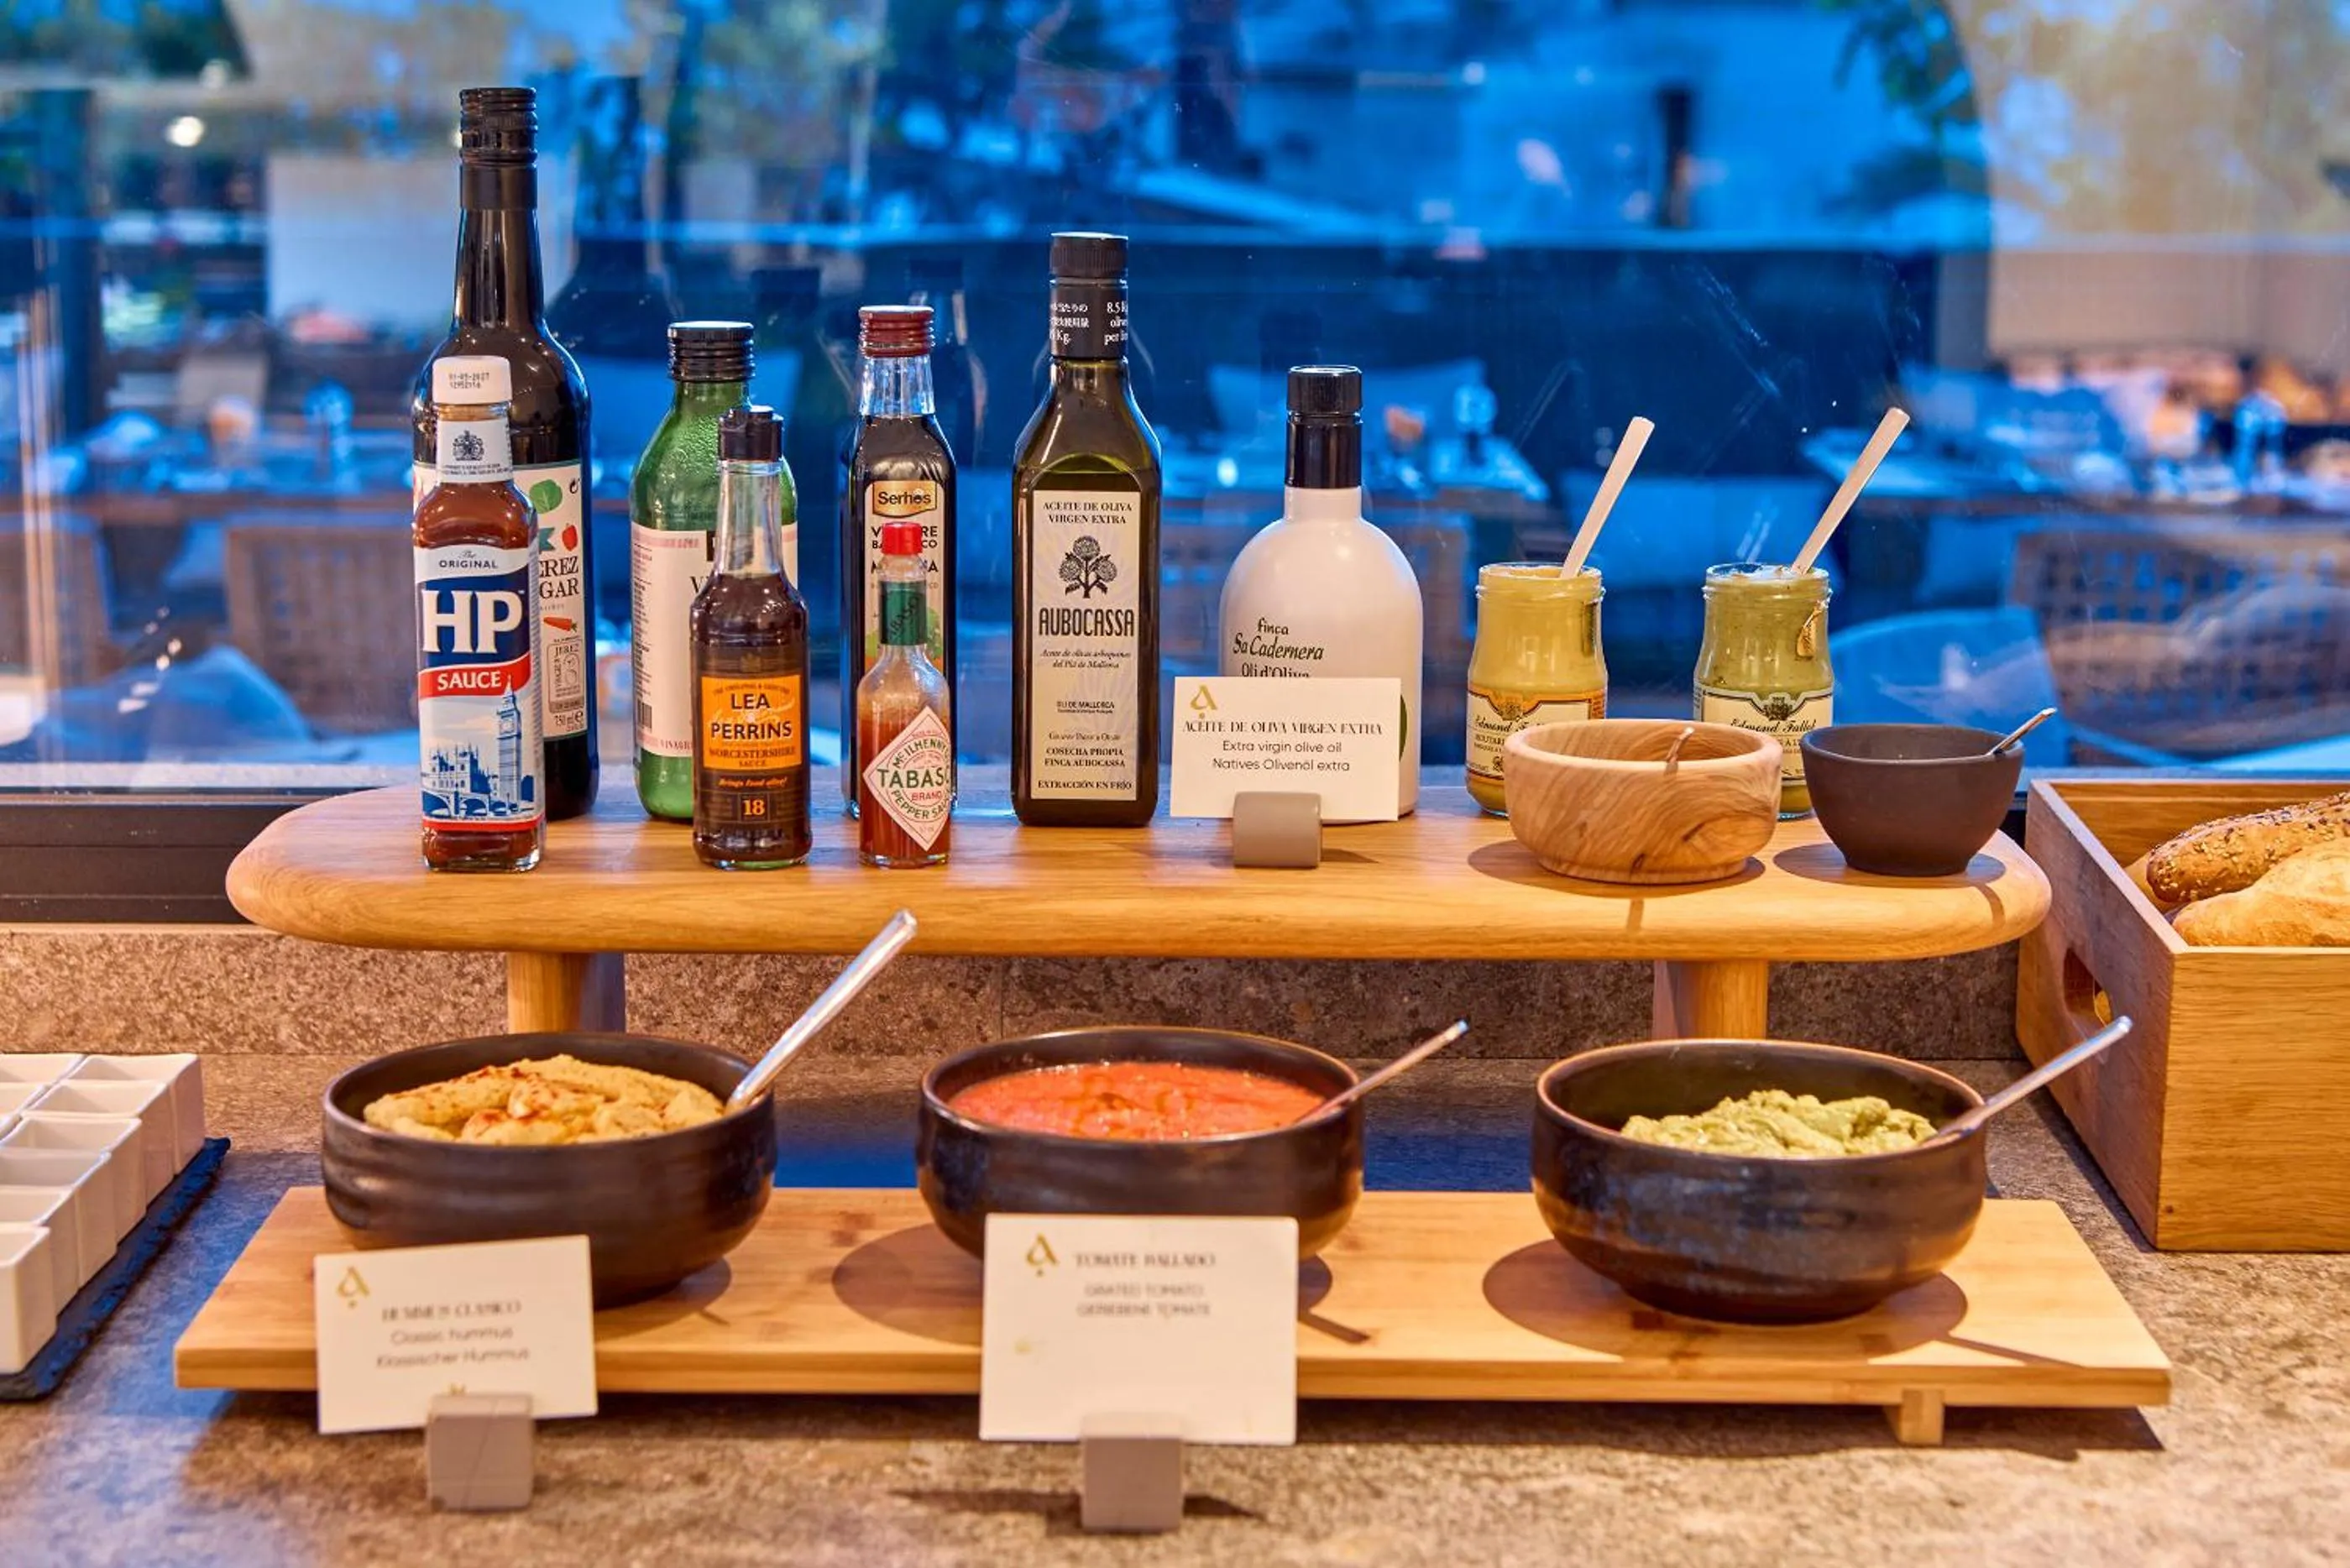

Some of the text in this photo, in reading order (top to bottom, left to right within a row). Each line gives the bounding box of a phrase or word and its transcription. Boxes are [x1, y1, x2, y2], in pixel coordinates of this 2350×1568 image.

[1043, 502, 1133, 511] ACEITE DE OLIVA
[1049, 514, 1127, 524] VIRGEN EXTRA
[438, 559, 498, 569] ORIGINAL
[421, 588, 523, 654] HP
[1039, 607, 1134, 637] AUBOCASSA
[1248, 635, 1324, 661] Cadernera
[437, 671, 502, 691] SAUCE
[730, 693, 772, 710] LEA
[710, 720, 793, 740] PERRINS
[1182, 720, 1384, 735] ACEITE DE OLIVA VIRGEN EXTRA
[1222, 740, 1342, 755] Extra virgin olive oil
[1212, 757, 1260, 771] Natives
[1316, 760, 1351, 771] extra
[1096, 781, 1108, 789] EN
[911, 790, 943, 801] BRAND
[742, 799, 766, 816] 18
[891, 789, 930, 819] PEPPER
